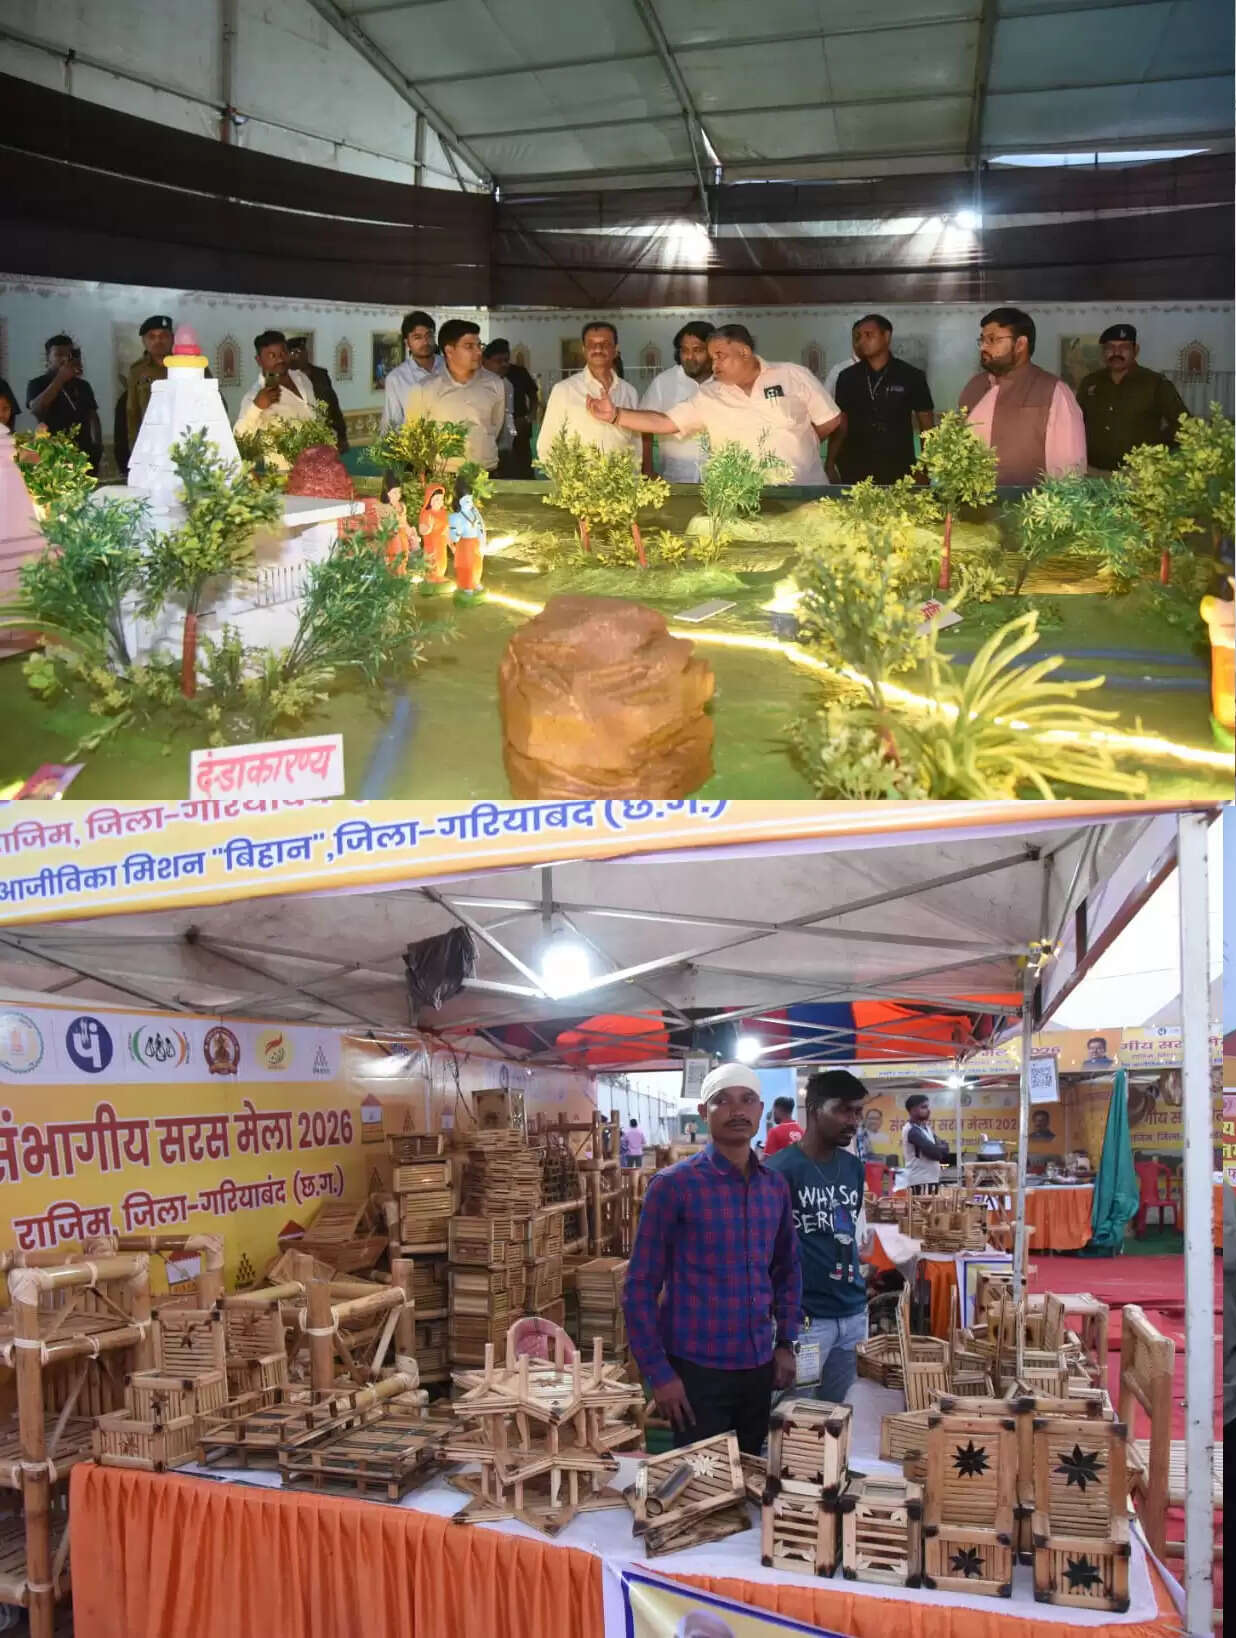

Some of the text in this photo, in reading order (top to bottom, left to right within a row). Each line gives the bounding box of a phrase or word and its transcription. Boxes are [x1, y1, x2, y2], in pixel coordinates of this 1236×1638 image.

[0, 821, 80, 853] ाजिम,
[123, 852, 206, 886] मिशन
[156, 1115, 231, 1165] सरस
[233, 1100, 294, 1155] मेला
[298, 1109, 353, 1149] 2026
[122, 1174, 287, 1232] जिला-गरियाबंद
[293, 1165, 345, 1204] (छ.ग.)
[798, 1185, 858, 1210] WHY SO
